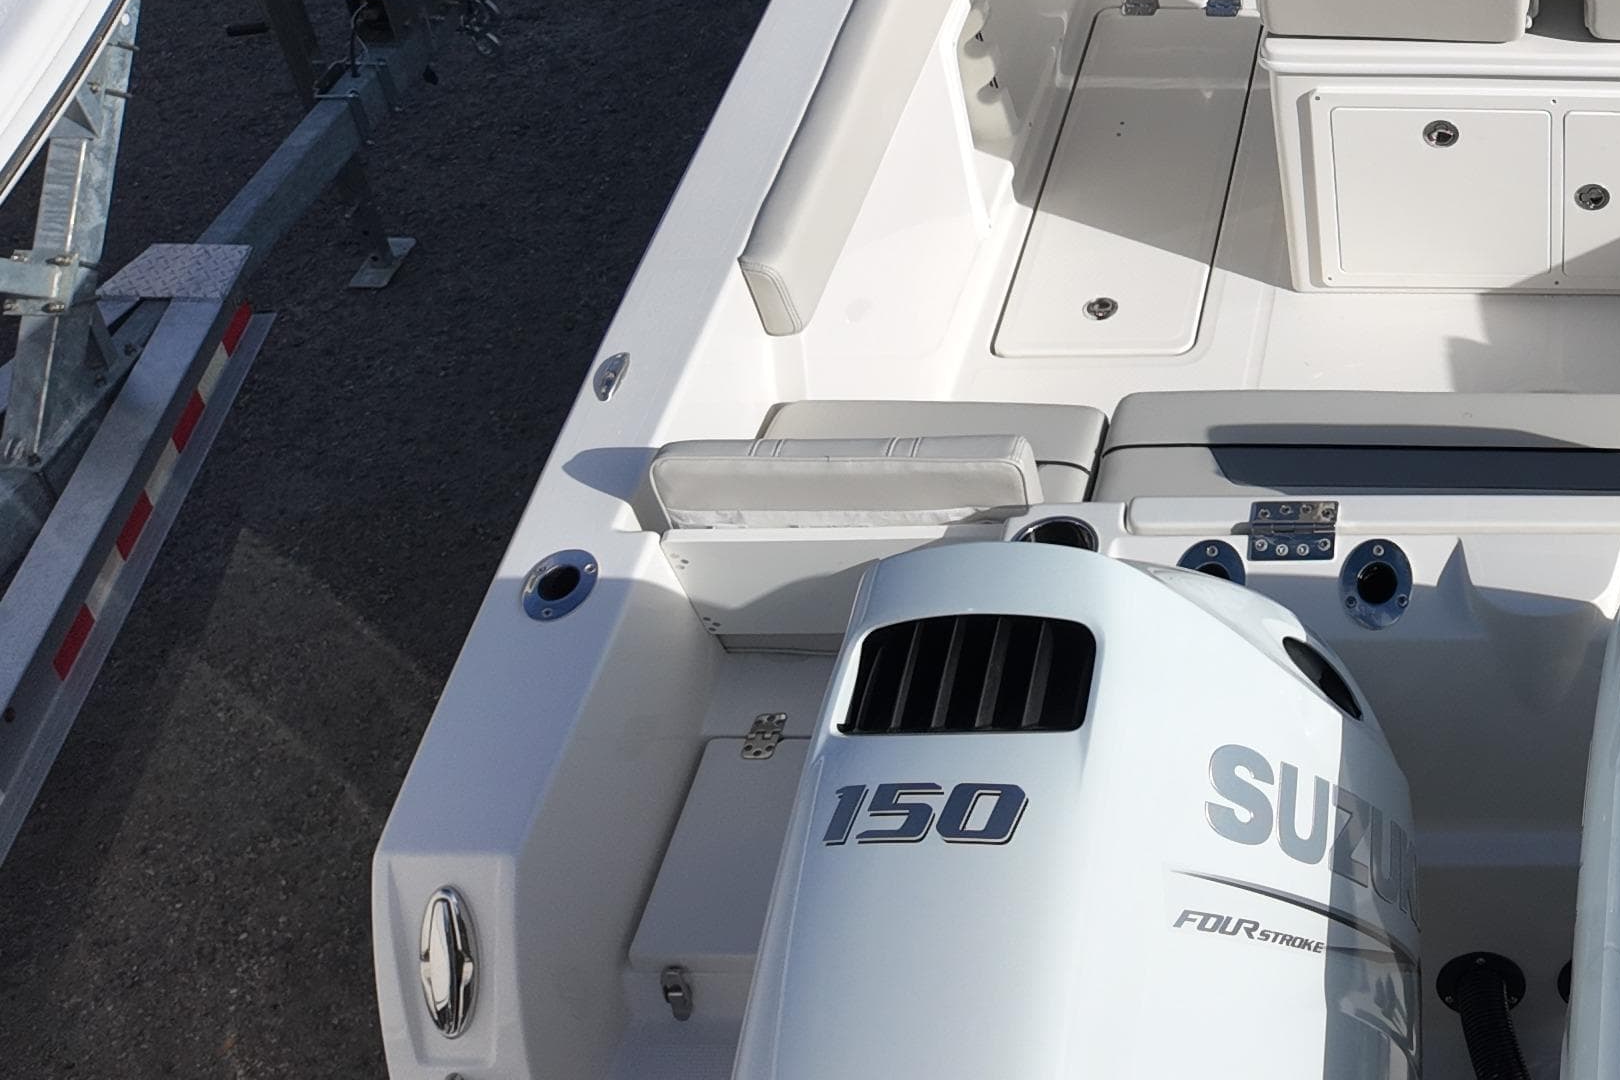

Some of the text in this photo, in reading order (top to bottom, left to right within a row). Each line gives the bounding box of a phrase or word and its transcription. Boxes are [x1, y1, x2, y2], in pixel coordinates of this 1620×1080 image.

[823, 782, 1029, 846] 150
[1173, 909, 1325, 954] FOUR STROKE
